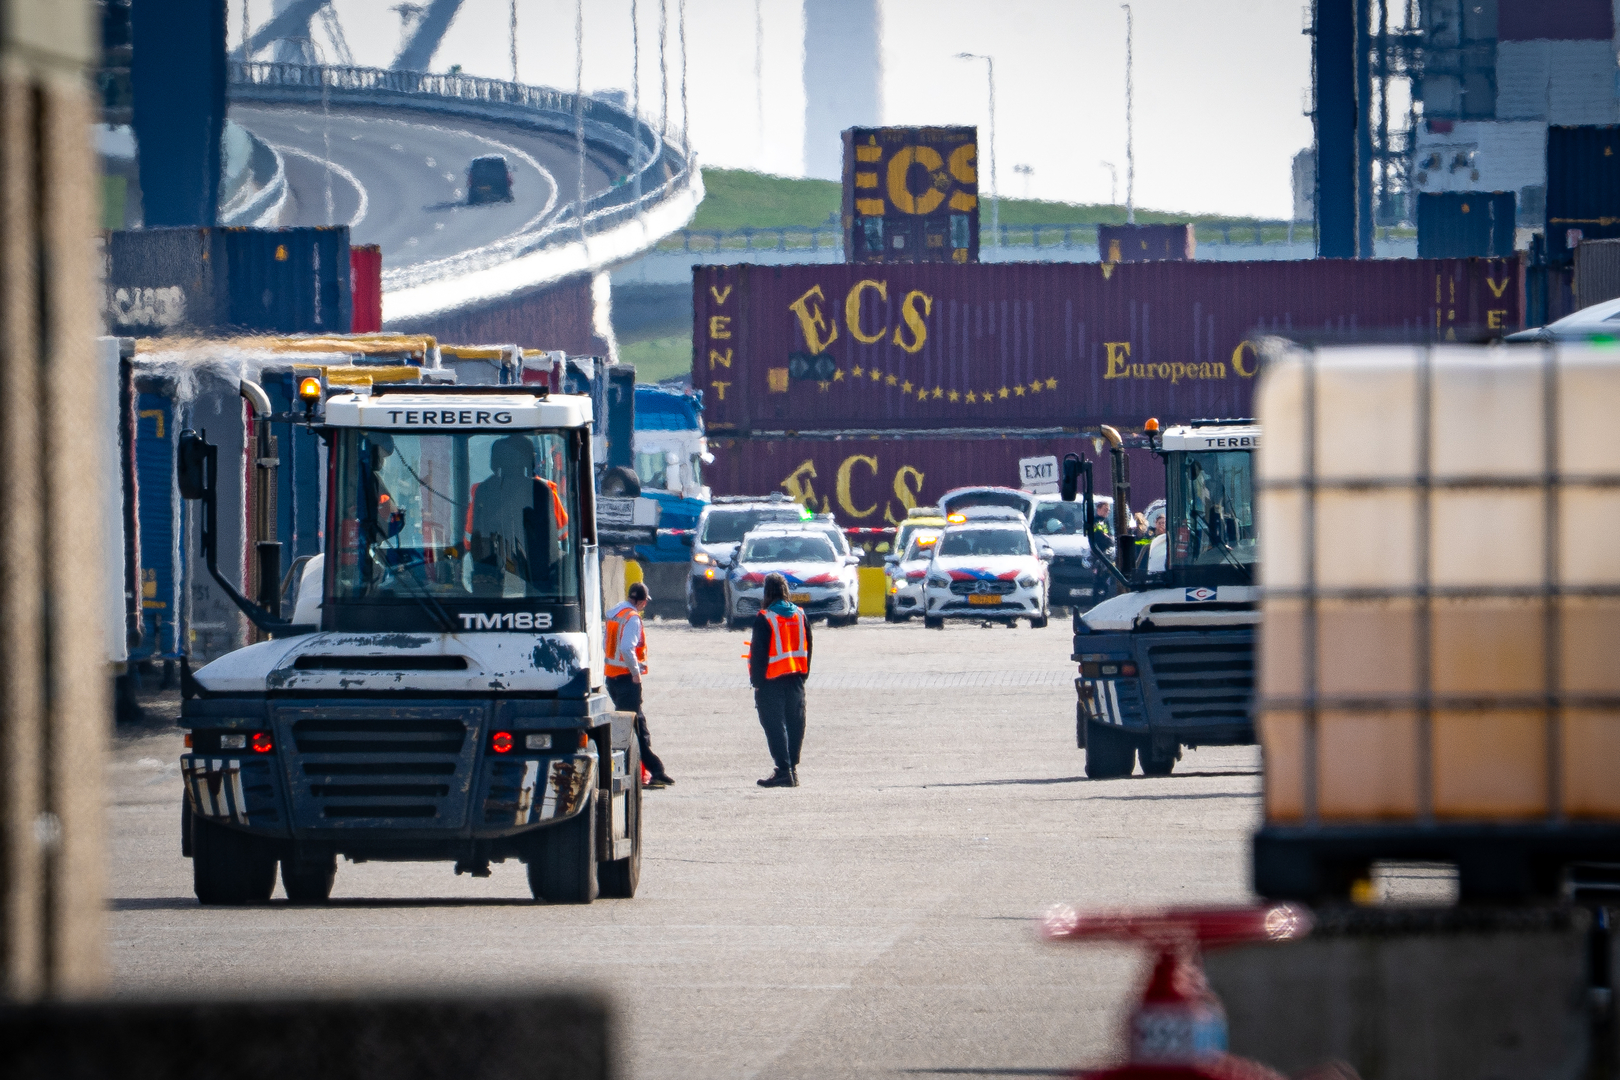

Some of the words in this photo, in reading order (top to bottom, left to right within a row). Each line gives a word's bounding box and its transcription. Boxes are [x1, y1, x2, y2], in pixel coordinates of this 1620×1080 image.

[856, 143, 977, 215] ECS
[709, 283, 733, 400] VENT
[789, 279, 934, 355] ECS
[1103, 341, 1227, 385] European
[387, 410, 513, 424] TERBERG
[780, 455, 925, 526] ECS
[1024, 463, 1053, 479] EXIT
[458, 612, 553, 630] TM188
